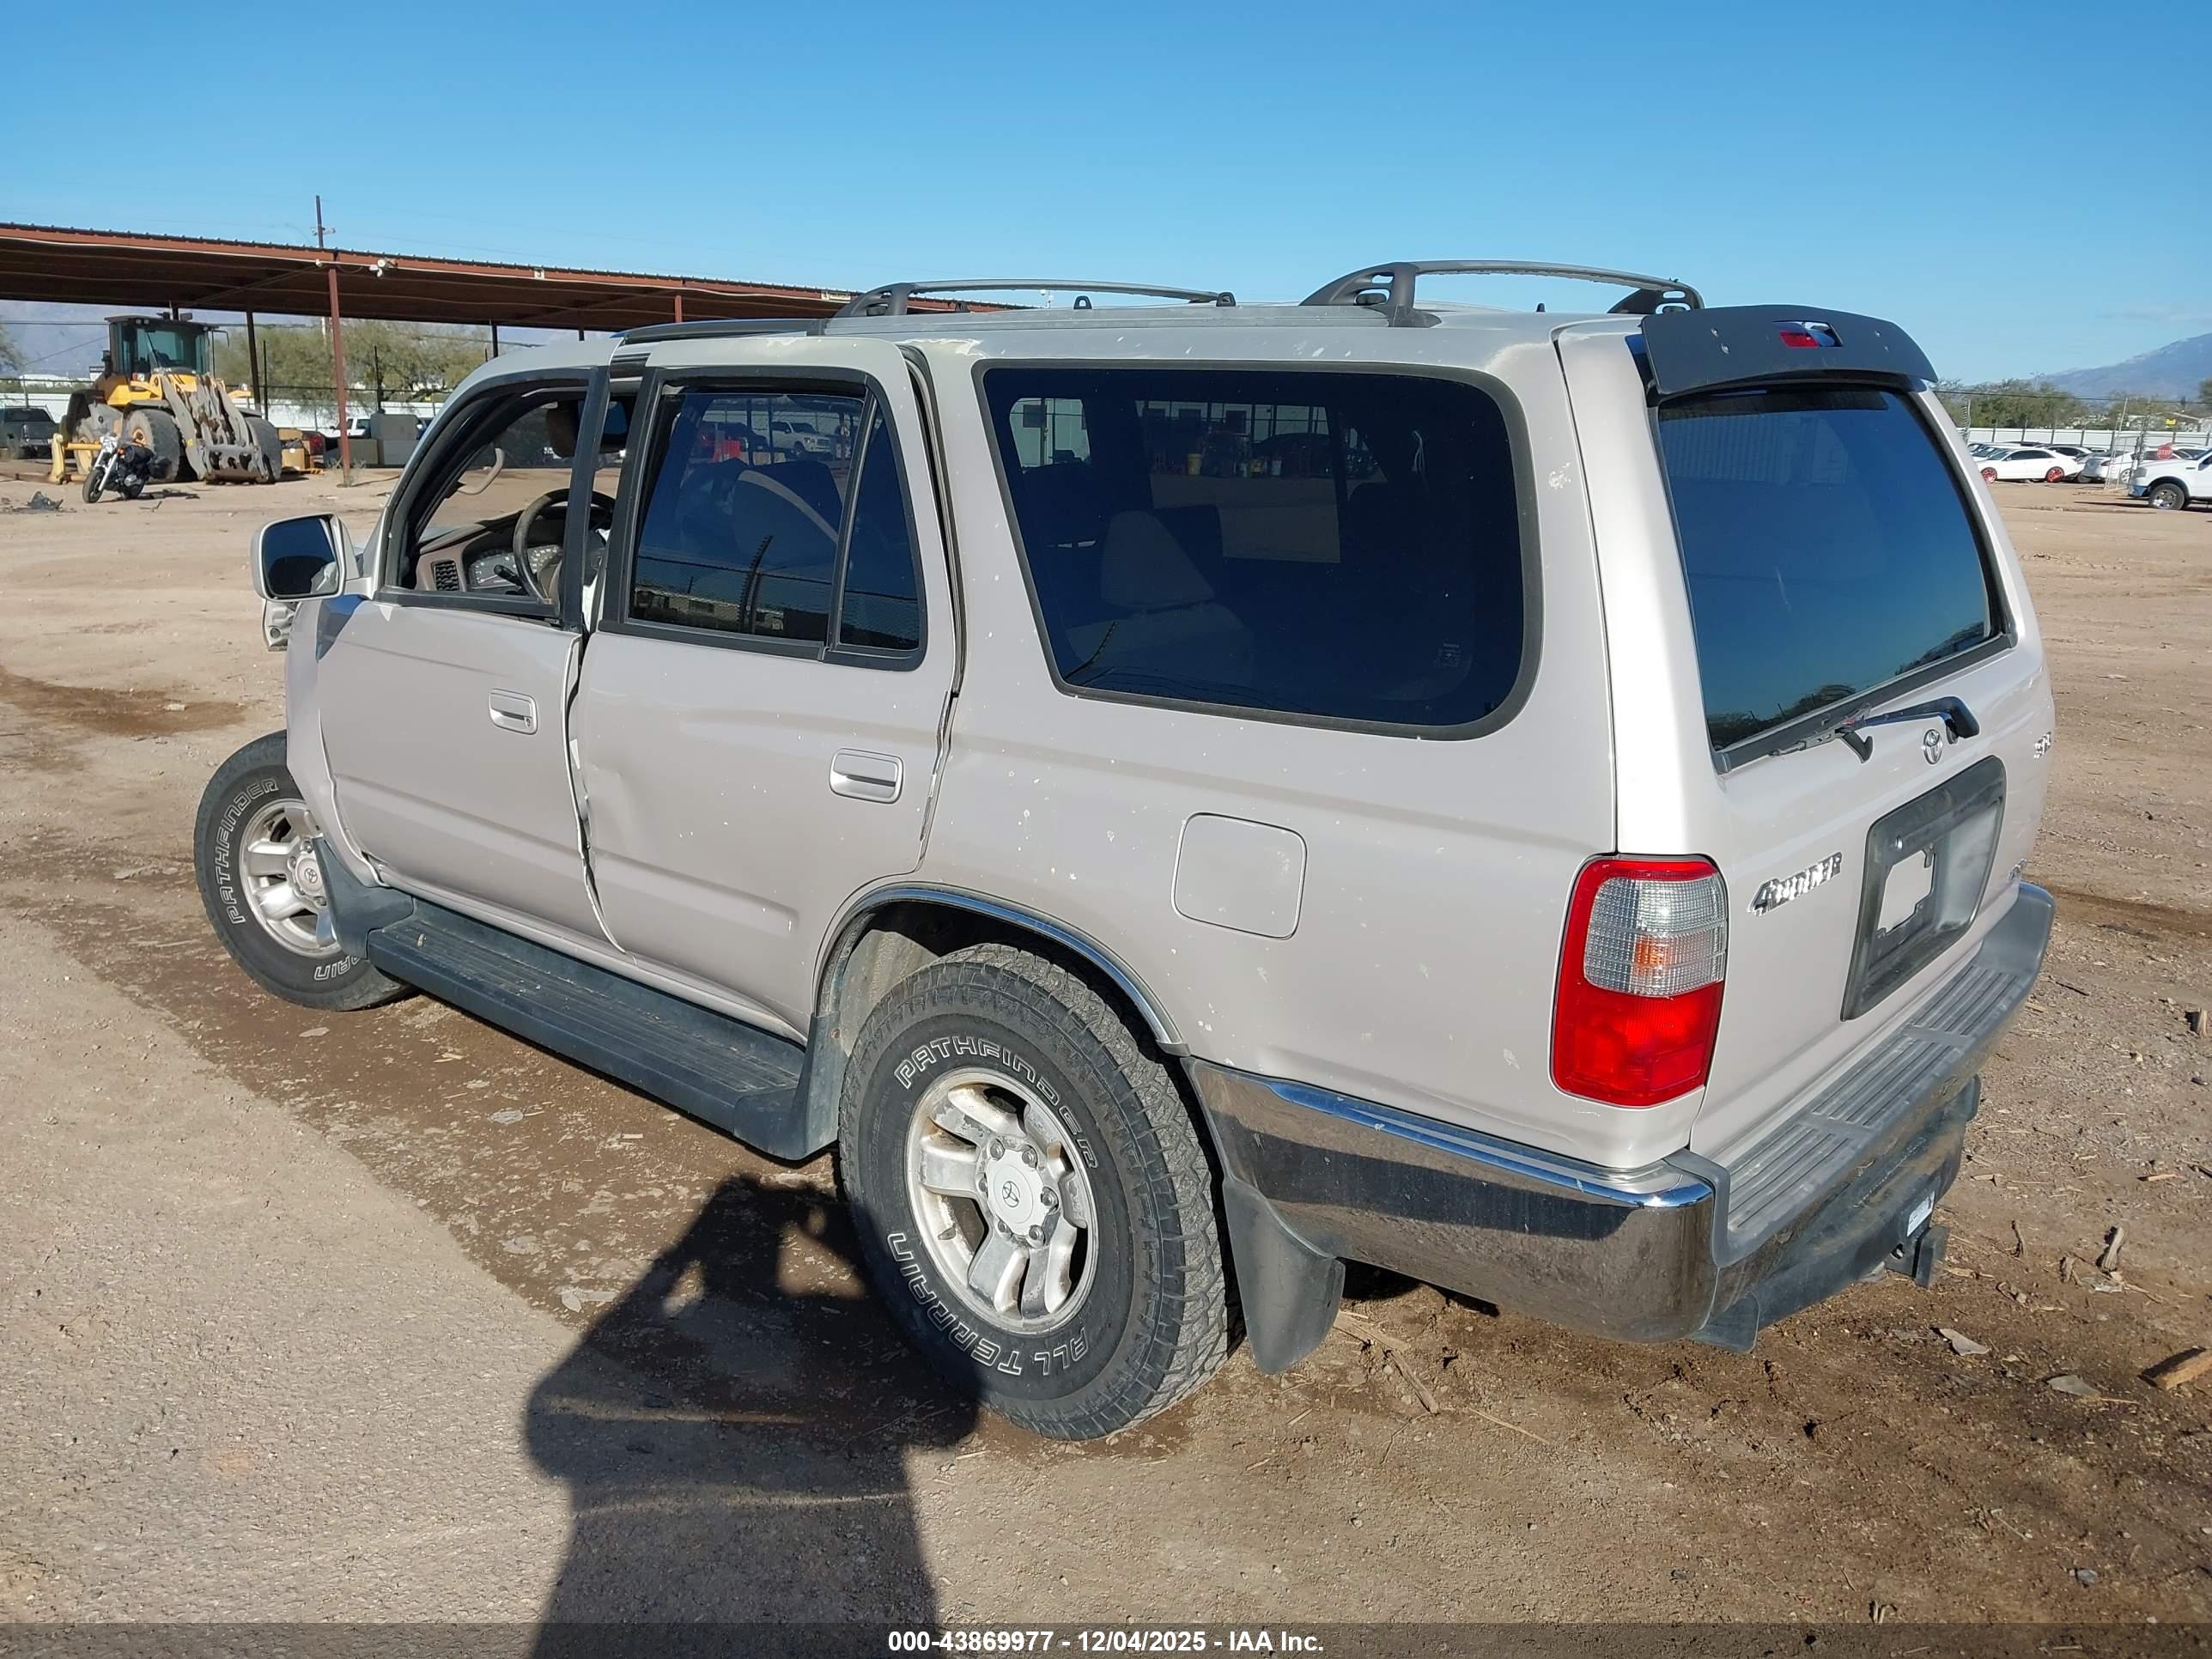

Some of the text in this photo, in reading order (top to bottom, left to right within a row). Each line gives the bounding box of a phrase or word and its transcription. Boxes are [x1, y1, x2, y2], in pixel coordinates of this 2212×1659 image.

[214, 777, 280, 926] PATHFINDER
[893, 1035, 1098, 1170] PATHFINDER
[886, 1232, 1090, 1376] ALL TERRAIN
